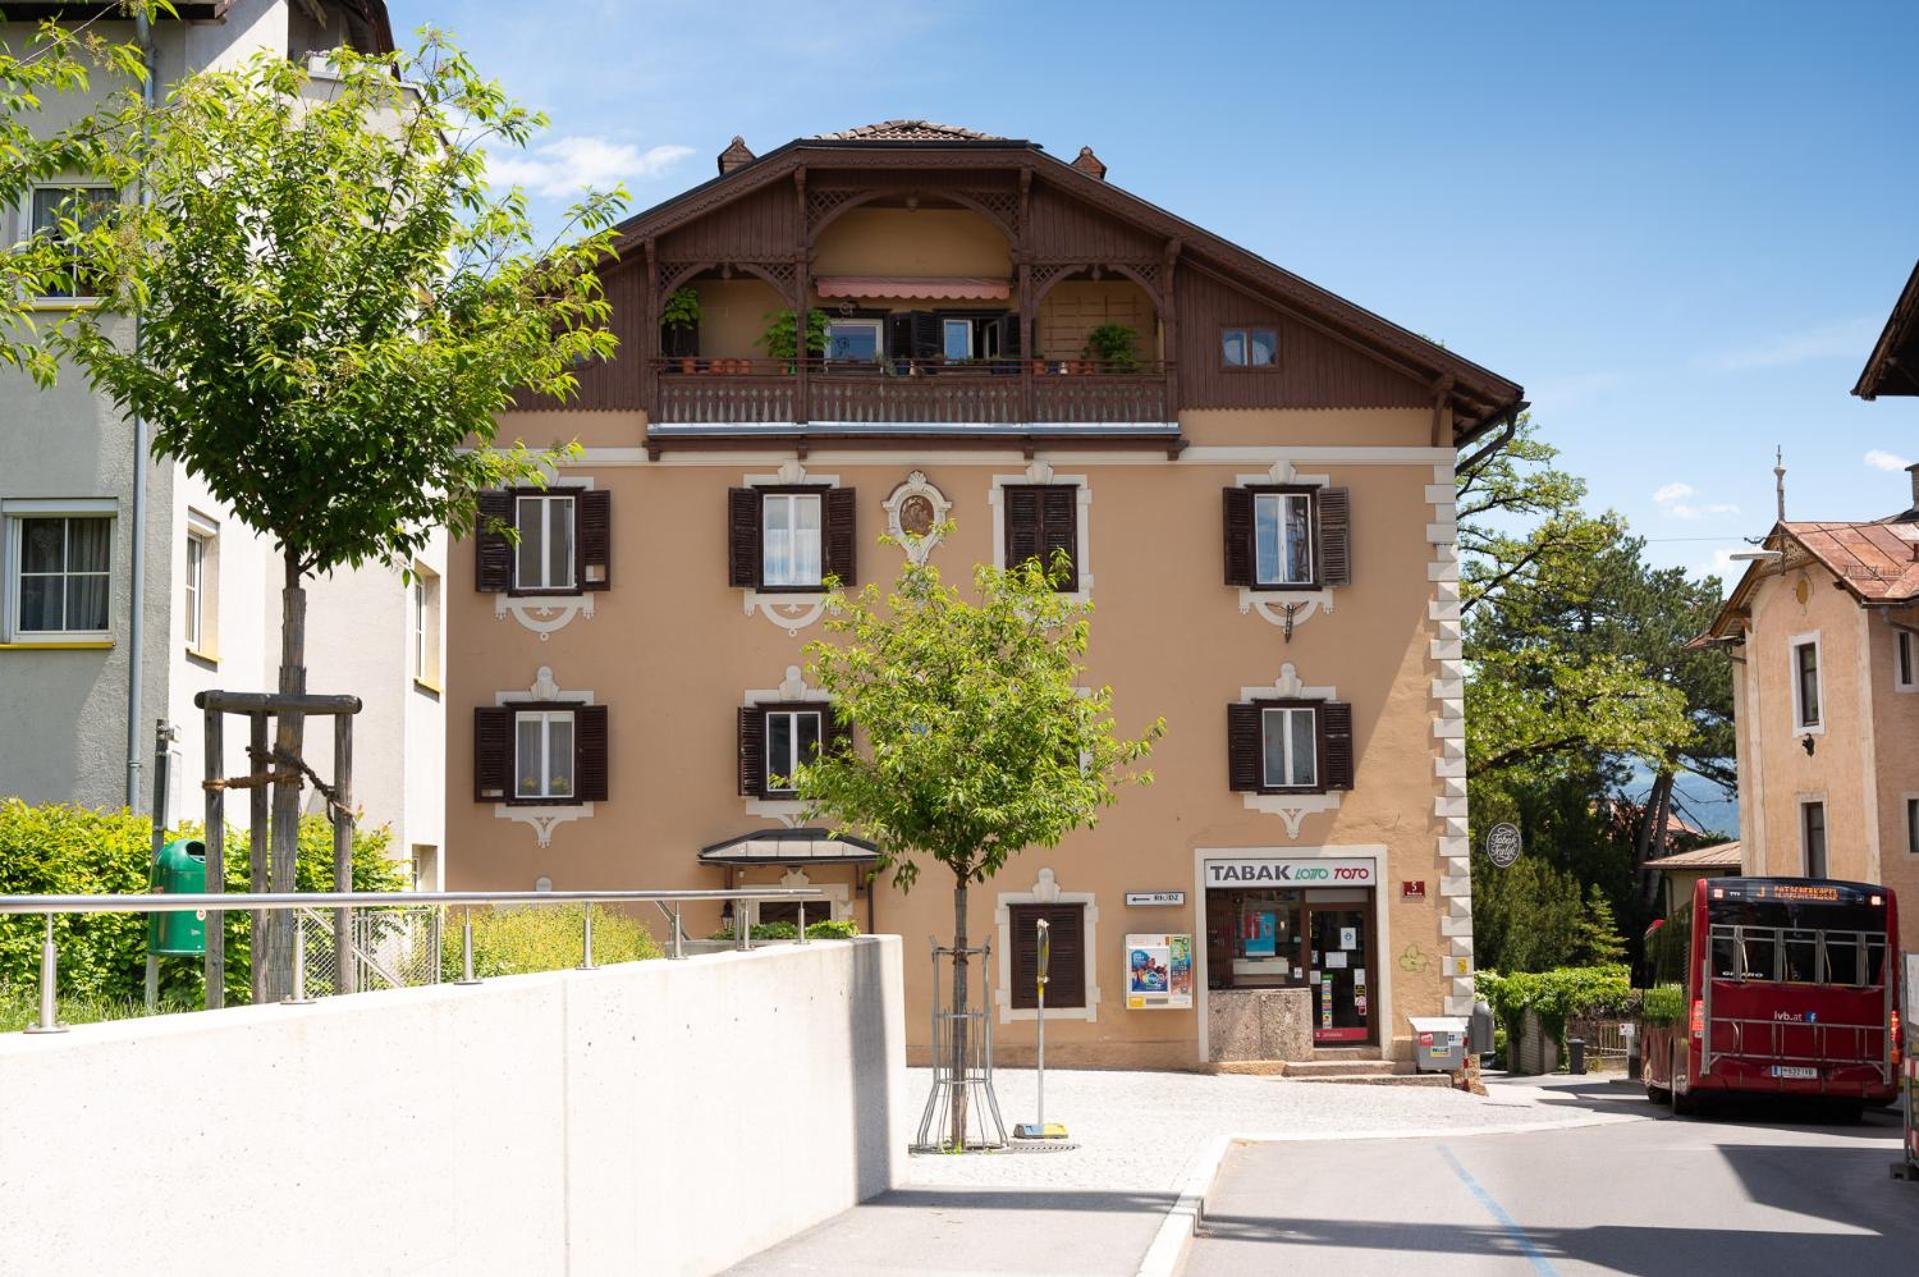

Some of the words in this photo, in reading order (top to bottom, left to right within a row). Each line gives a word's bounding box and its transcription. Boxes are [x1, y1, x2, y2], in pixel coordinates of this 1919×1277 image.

[1210, 865, 1291, 881] TABAK
[1294, 868, 1329, 880] LOTTO
[1333, 868, 1369, 880] TOTO
[1722, 970, 1764, 978] CIARO
